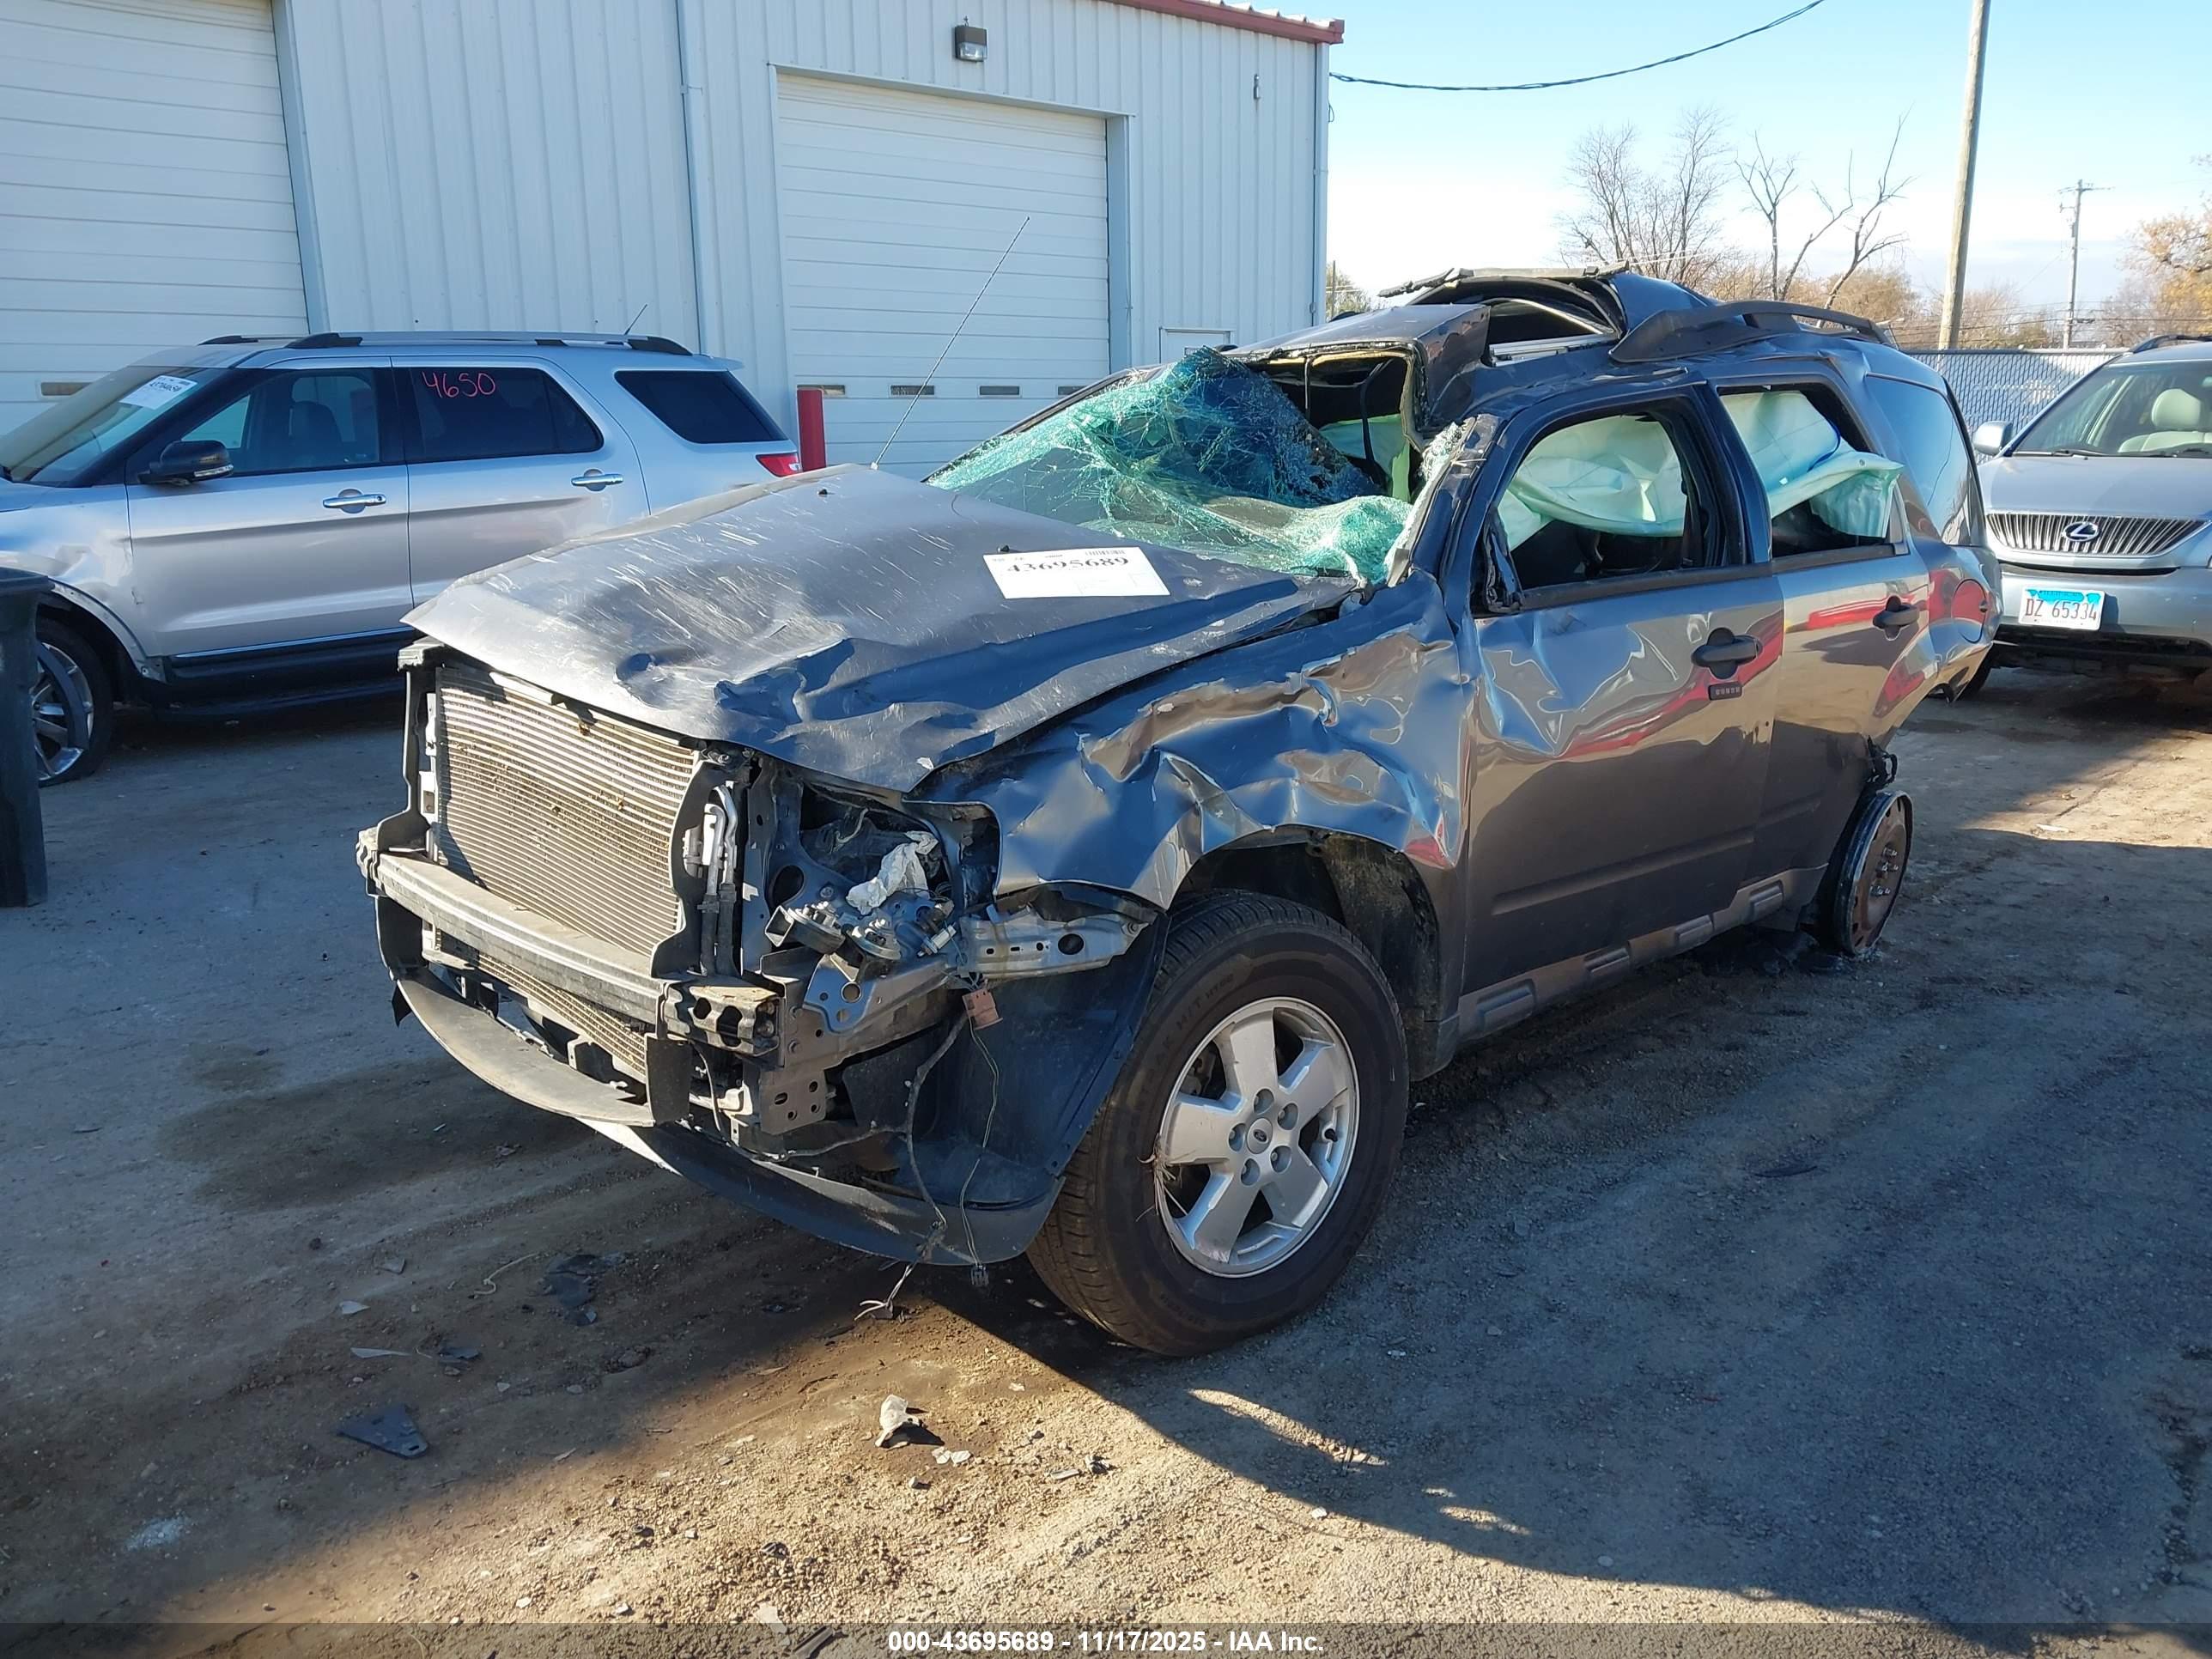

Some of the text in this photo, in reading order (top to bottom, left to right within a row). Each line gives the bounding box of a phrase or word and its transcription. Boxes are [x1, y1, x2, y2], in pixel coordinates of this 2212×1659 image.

[422, 371, 495, 398] 4650
[1007, 556, 1129, 573] 43695689
[2026, 599, 2097, 620] DZ 65334
